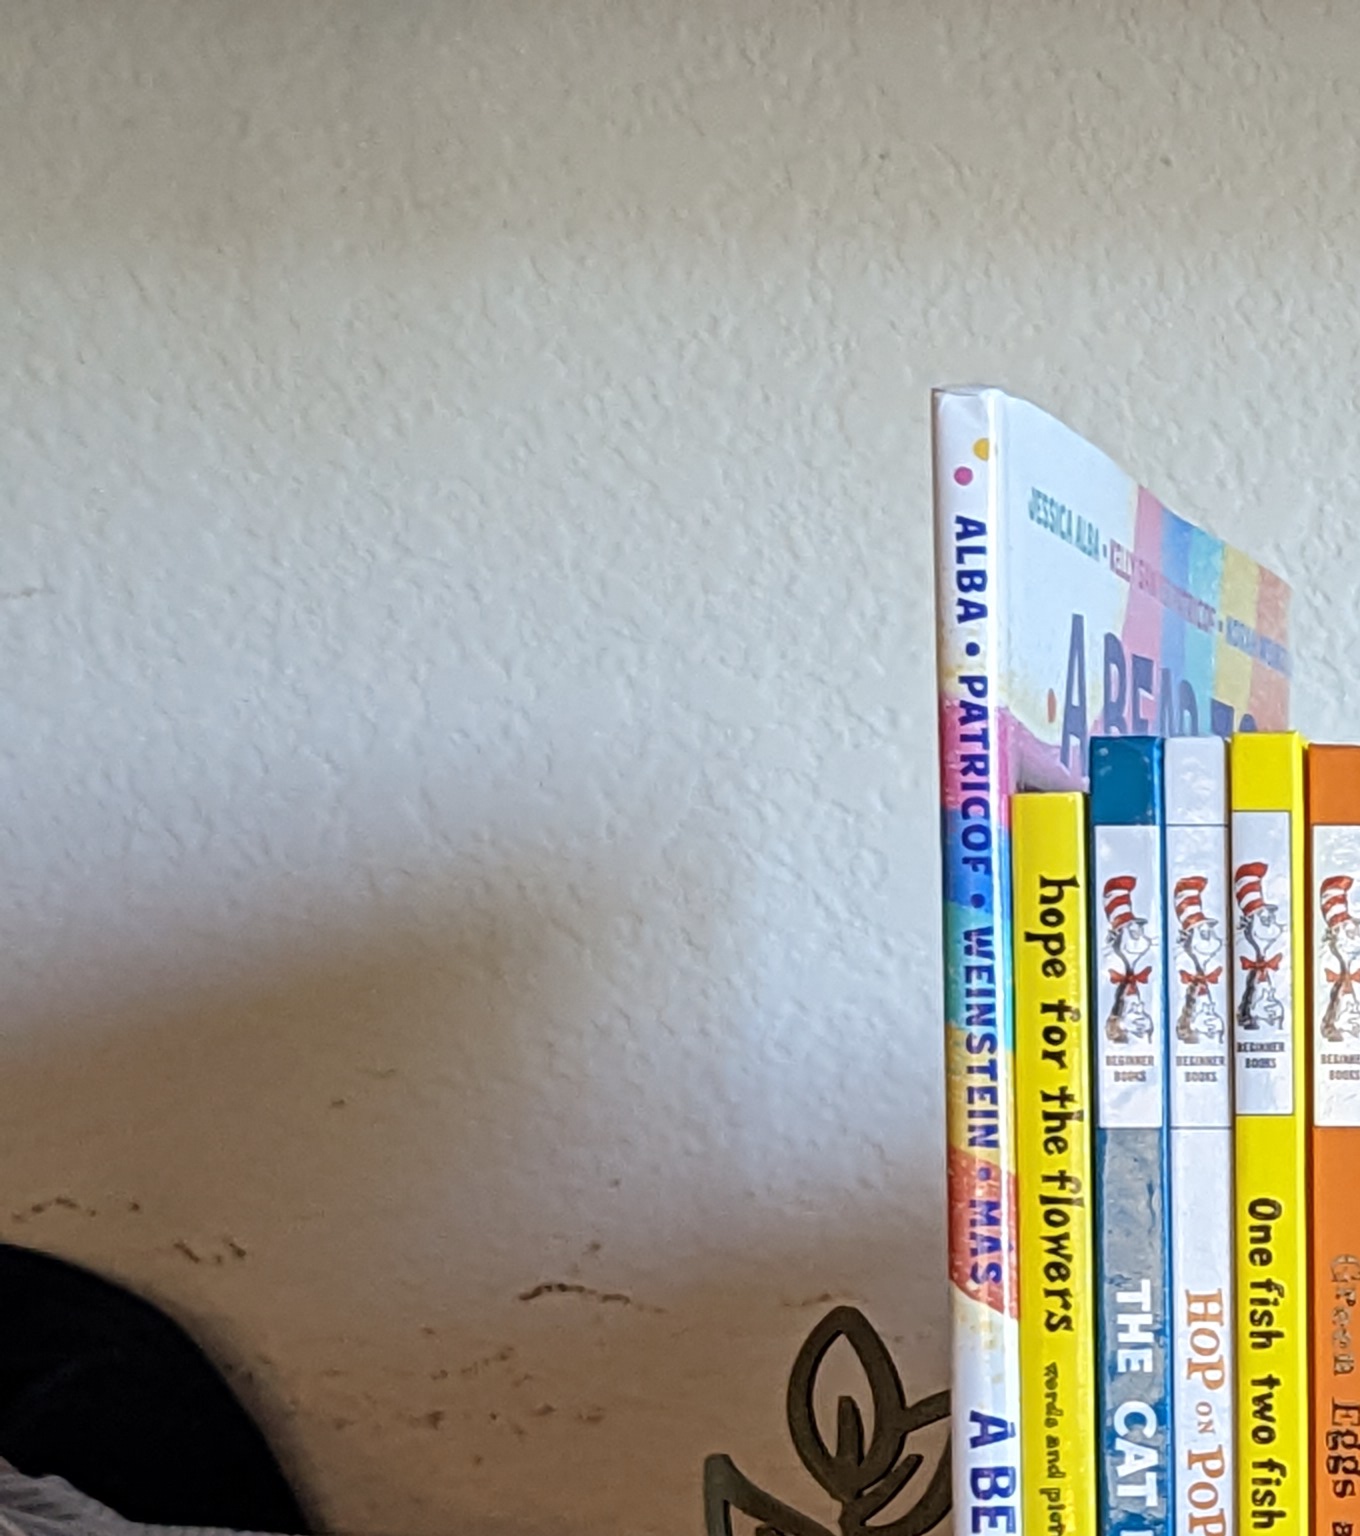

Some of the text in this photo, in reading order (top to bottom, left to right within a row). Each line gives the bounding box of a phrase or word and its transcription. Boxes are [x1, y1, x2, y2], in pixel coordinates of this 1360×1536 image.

[955, 515, 989, 623] ALBA
[957, 674, 993, 874] PATRICOF
[962, 925, 1000, 1149] WEINSTEIN
[1025, 875, 1084, 1332] hope for the flowers
[1247, 1198, 1282, 1268] One
[1115, 1279, 1152, 1374] THE
[1185, 1289, 1225, 1391] HOP
[1248, 1276, 1284, 1350] fish
[969, 1410, 1016, 1449] A
[1196, 1402, 1216, 1434] ON
[1250, 1374, 1283, 1445] two
[1046, 1434, 1066, 1478] and
[1112, 1400, 1158, 1507] CAT
[1251, 1458, 1287, 1530] fish
